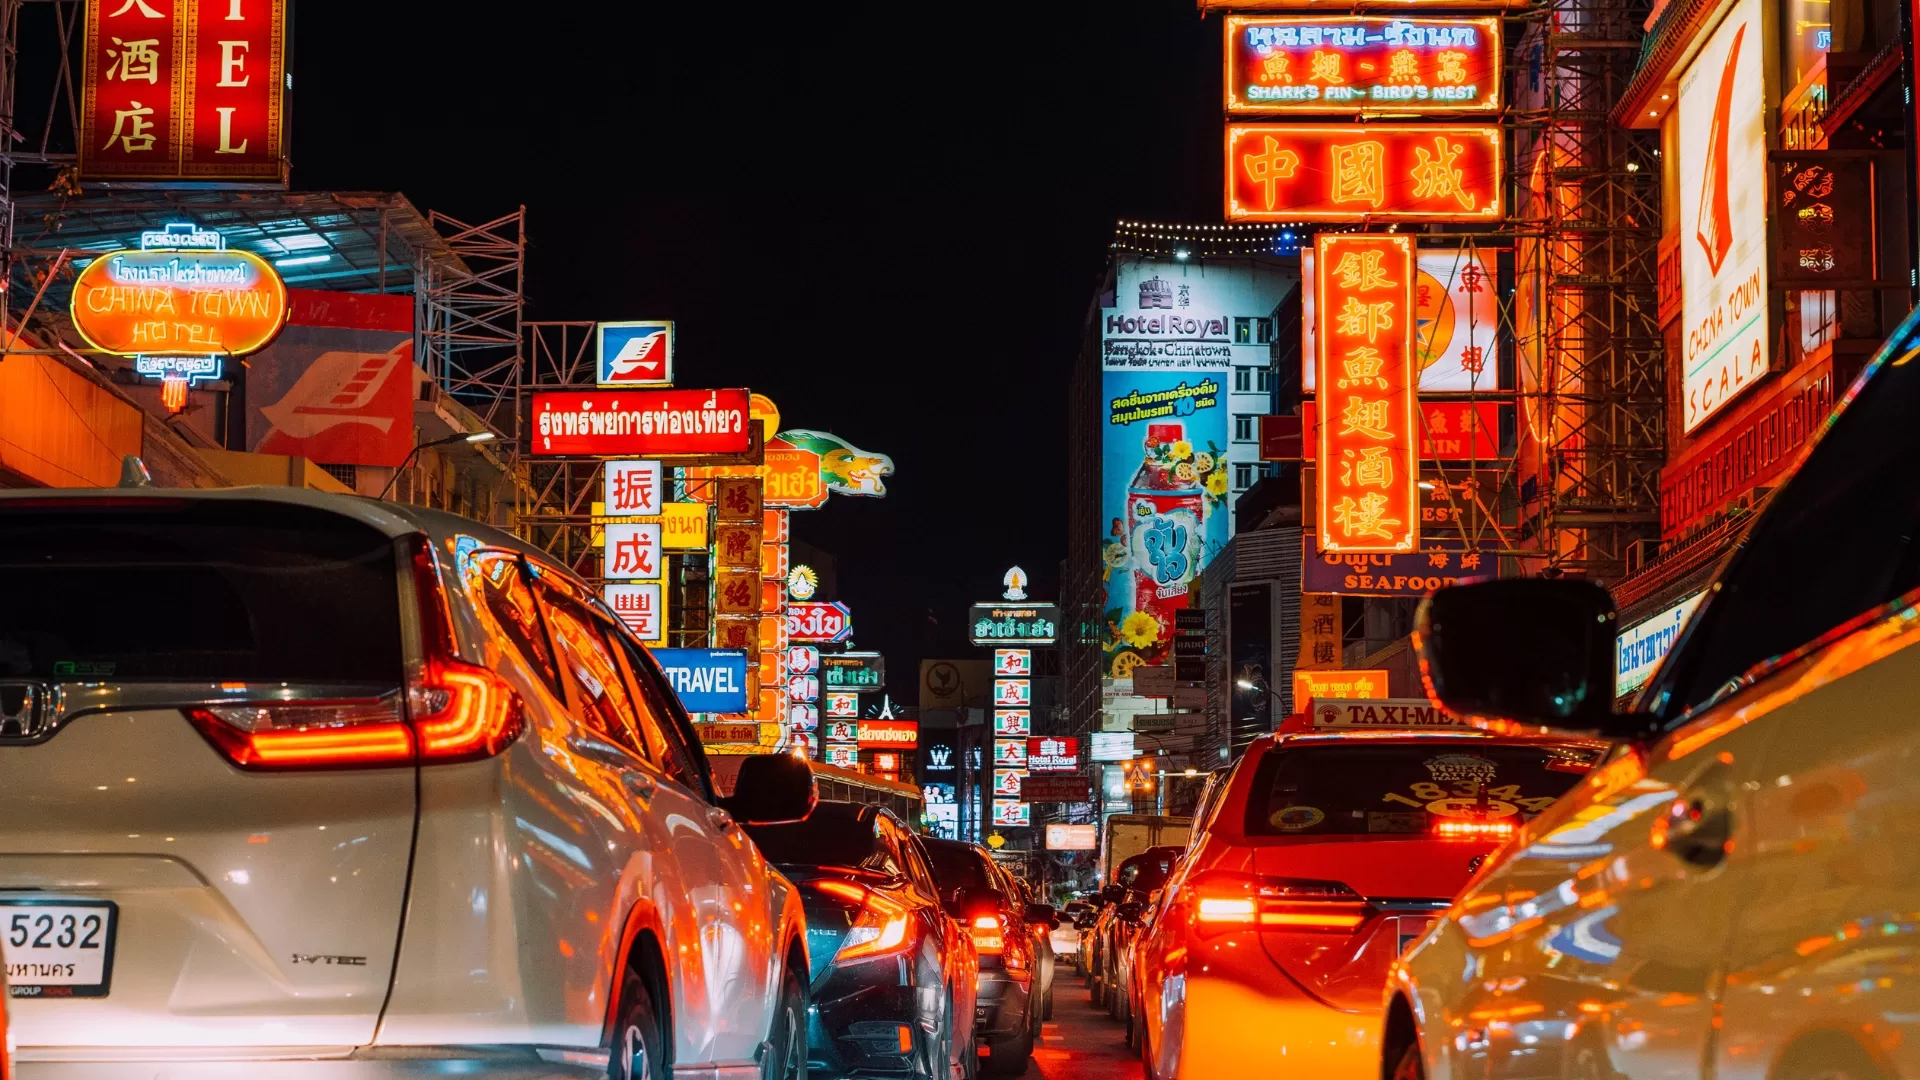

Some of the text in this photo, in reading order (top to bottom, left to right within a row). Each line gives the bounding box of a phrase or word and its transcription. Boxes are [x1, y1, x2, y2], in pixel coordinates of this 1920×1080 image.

[1248, 84, 1319, 99] SHARK'S
[1373, 85, 1428, 98] BIRD'S
[1433, 86, 1476, 99] NEST
[1244, 136, 1475, 210] 中國城
[87, 286, 271, 317] CHINA TOWN
[1688, 266, 1761, 362] CHINA TOWN
[133, 321, 222, 346] HOTEL
[1107, 315, 1228, 338] Hotel Royal
[1104, 339, 1231, 358] Bangkok Chinatown
[1689, 338, 1761, 424] SCALA
[1332, 249, 1401, 540] 銀都魚翅酒樓
[1174, 398, 1196, 417] 10
[538, 391, 742, 450] รุ่งทรัพย์การท่องเที่ยว
[1423, 439, 1461, 454] FIN
[1422, 507, 1463, 522] EST
[1177, 640, 1205, 650] RADO
[666, 667, 739, 692] TRAVEL
[1347, 705, 1462, 725] TAXI-ME
[1028, 754, 1077, 765] Hotel Royal
[10, 914, 102, 949] 5232
